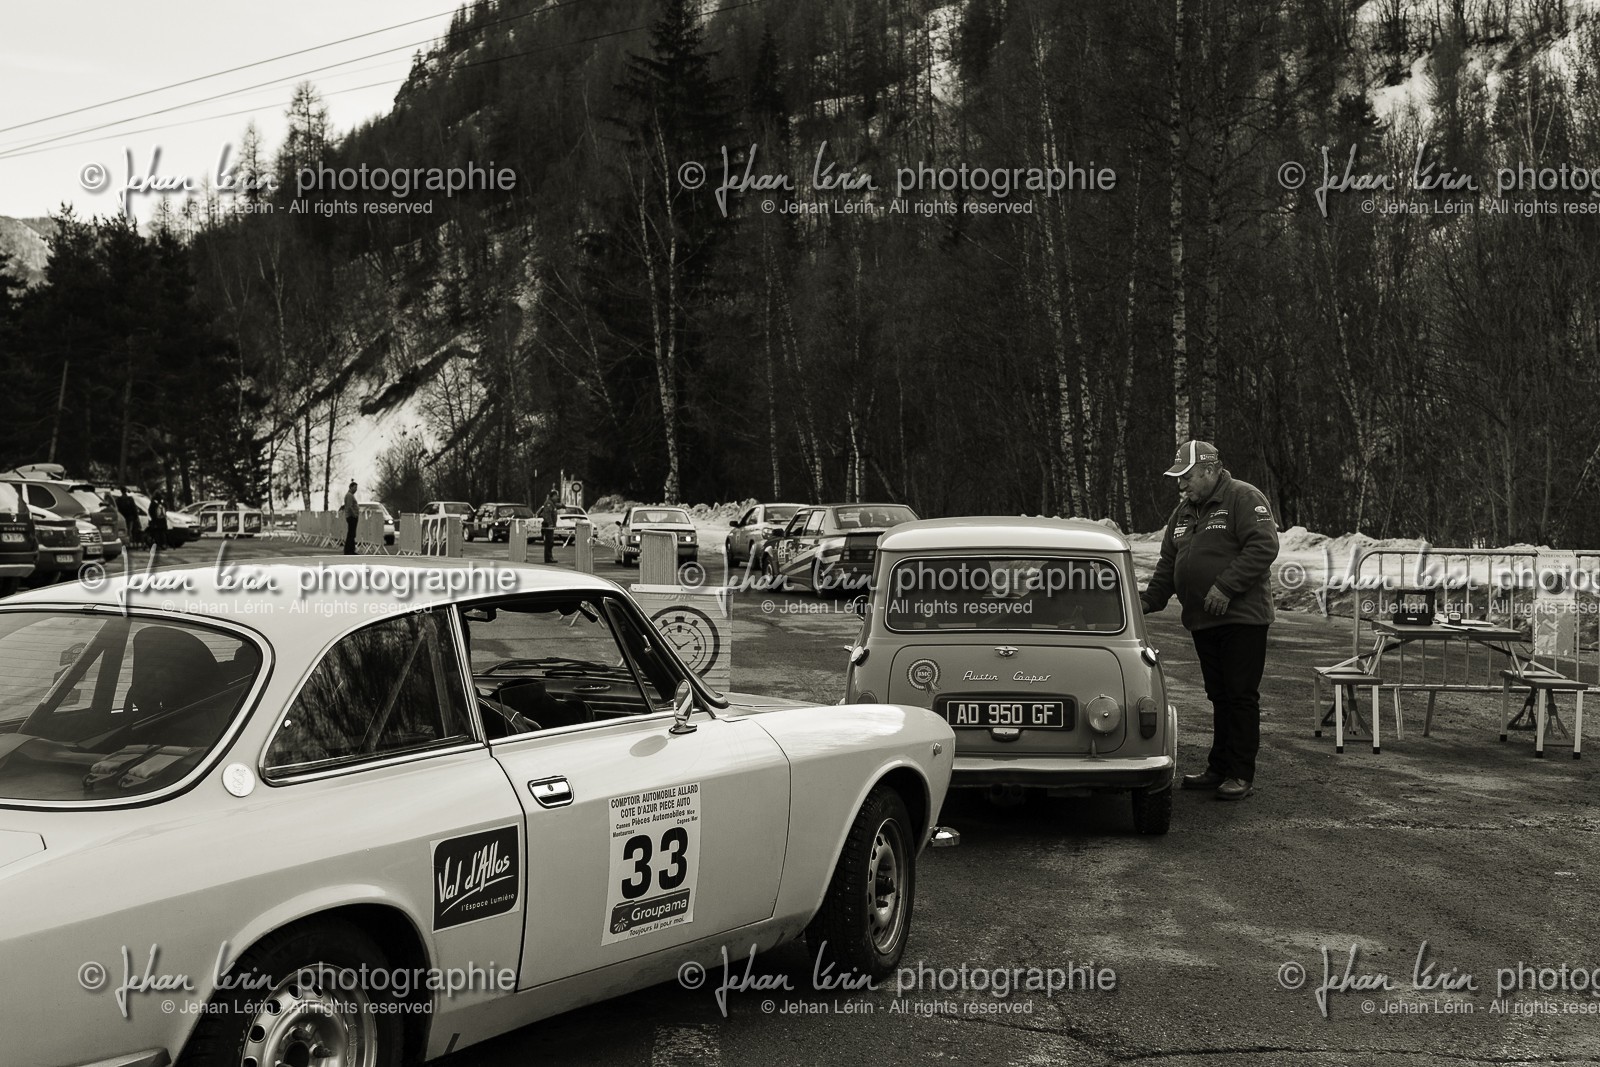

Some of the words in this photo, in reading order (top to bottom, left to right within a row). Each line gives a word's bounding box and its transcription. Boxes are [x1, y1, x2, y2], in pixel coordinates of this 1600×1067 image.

[963, 670, 999, 682] Austin
[1012, 670, 1051, 684] Cooper
[956, 704, 980, 724] AD
[988, 704, 1023, 724] 950
[1032, 704, 1055, 724] GF
[611, 795, 640, 808] COMPTOIR
[642, 788, 676, 803] AUTOMOBILE
[678, 784, 698, 796] ALLARD
[620, 807, 636, 818] COTE
[638, 803, 658, 816] D'AZUR
[660, 800, 674, 811] PIECE
[676, 796, 690, 808] AUTO
[632, 816, 650, 826] Pièces
[652, 810, 685, 822] Automobiles
[438, 856, 462, 903] Val
[464, 840, 510, 892] d'Allos
[622, 827, 688, 899] 33
[462, 900, 488, 912] l'Espace
[490, 893, 514, 905] Lumière
[632, 899, 687, 920] Groupama
[630, 926, 652, 936] Toujours
[660, 920, 672, 928] pour
